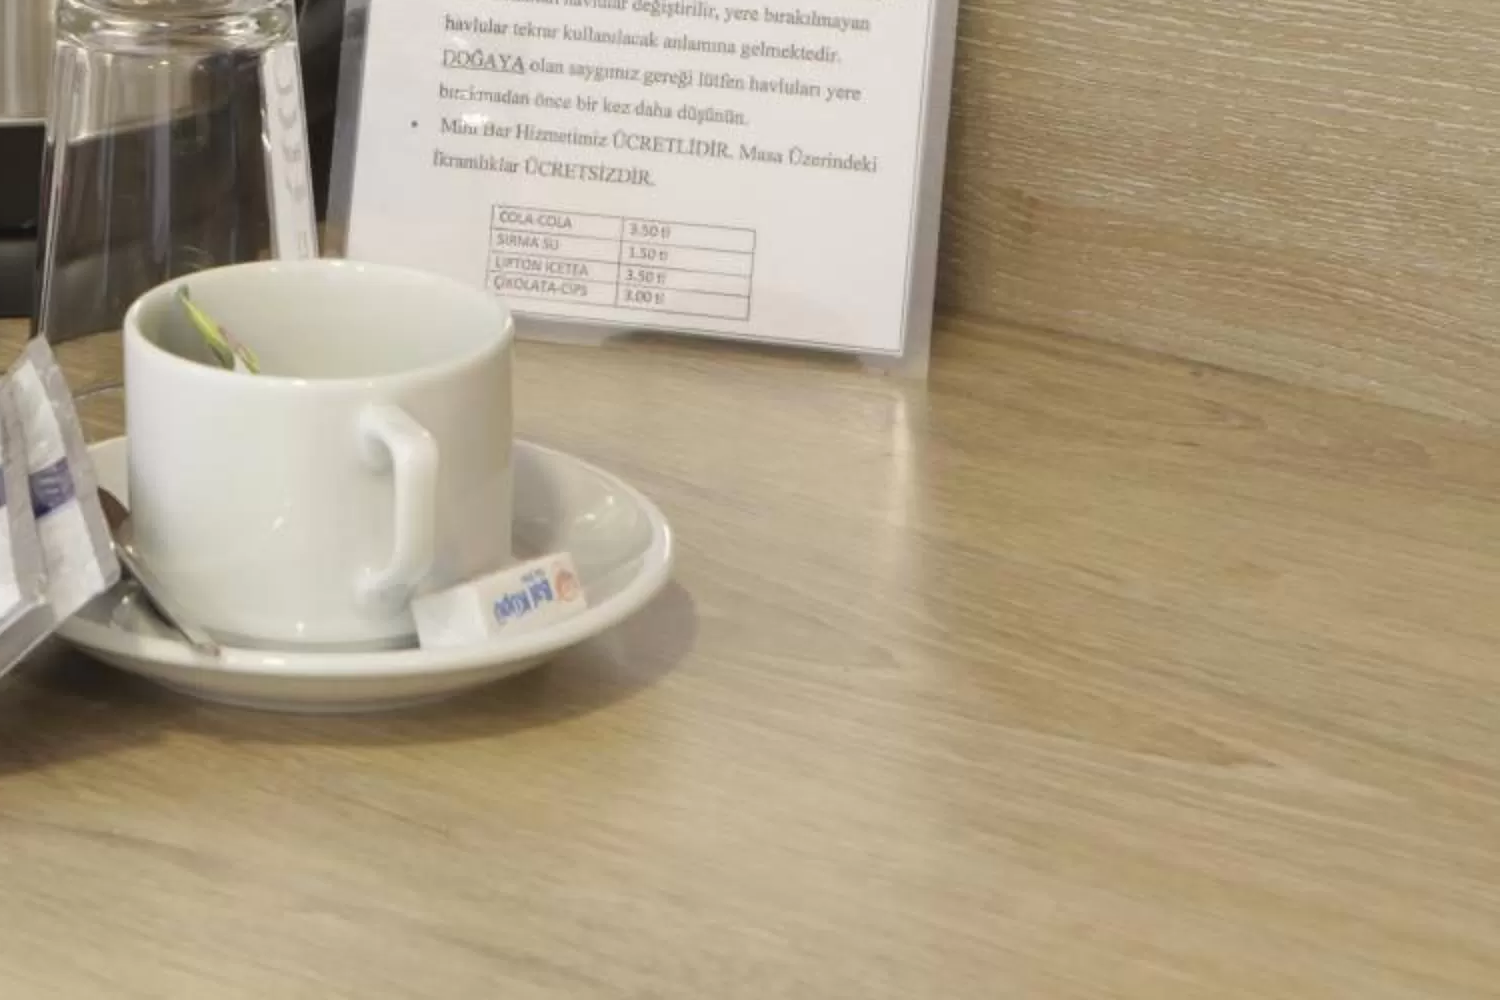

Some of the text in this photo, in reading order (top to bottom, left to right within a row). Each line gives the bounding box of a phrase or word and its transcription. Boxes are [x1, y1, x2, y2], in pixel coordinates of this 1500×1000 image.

[443, 13, 838, 64] havlular tekrar kullanılacak anlamına gelmektedir.
[722, 6, 760, 24] yere
[763, 7, 871, 33] bırakılmayan
[441, 47, 863, 103] DOĞAYA olan saygımız gereği lütfen havluları yere
[533, 92, 573, 110] önce
[575, 94, 600, 114] bir
[602, 95, 632, 116] kez
[633, 99, 674, 120] daha
[515, 122, 609, 148] Hizmetimiz
[738, 142, 784, 165] Masa
[787, 145, 878, 174] Üzerindeki
